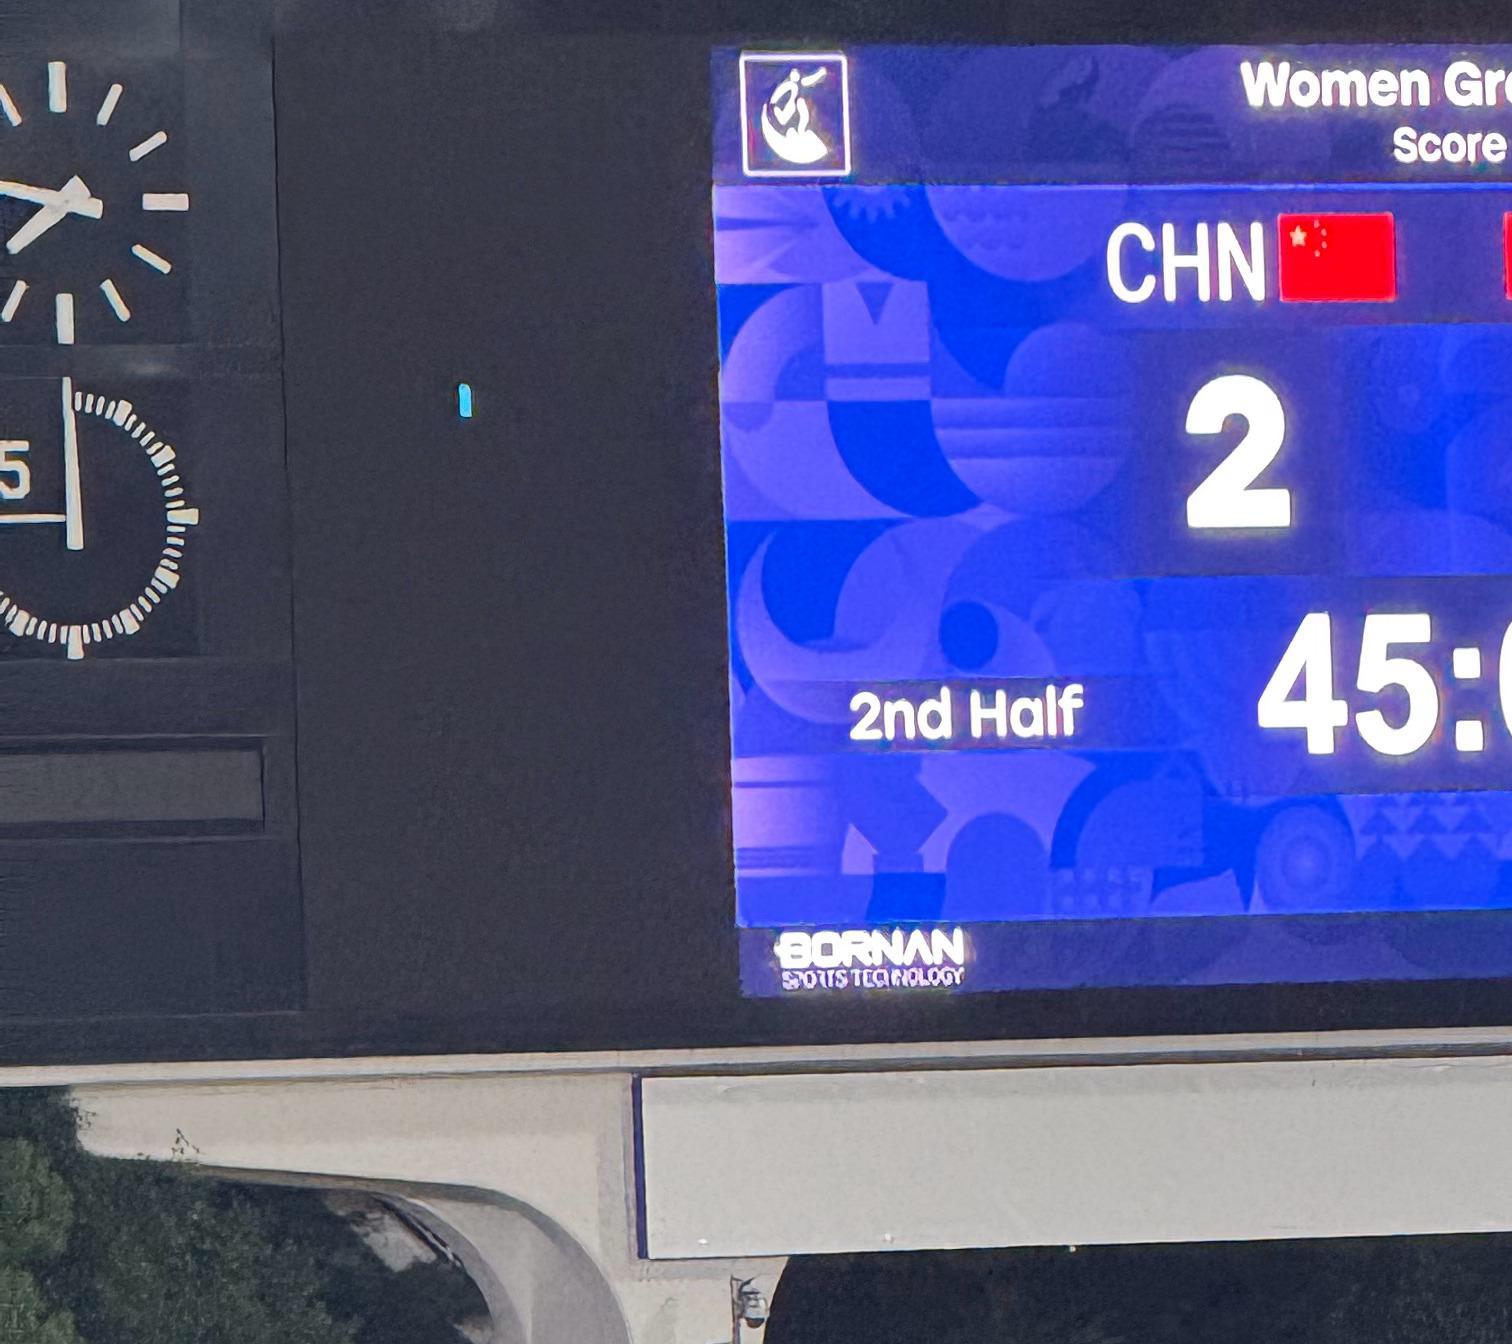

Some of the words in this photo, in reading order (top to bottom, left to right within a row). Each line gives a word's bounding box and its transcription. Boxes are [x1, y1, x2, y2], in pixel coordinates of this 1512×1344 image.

[1239, 60, 1431, 109] Women
[1393, 127, 1508, 163] Score
[1106, 221, 1266, 303] CHN
[1185, 374, 1291, 528] 2
[849, 686, 952, 740] 2nd
[969, 684, 1084, 738] Half
[774, 927, 965, 969] BORNAN
